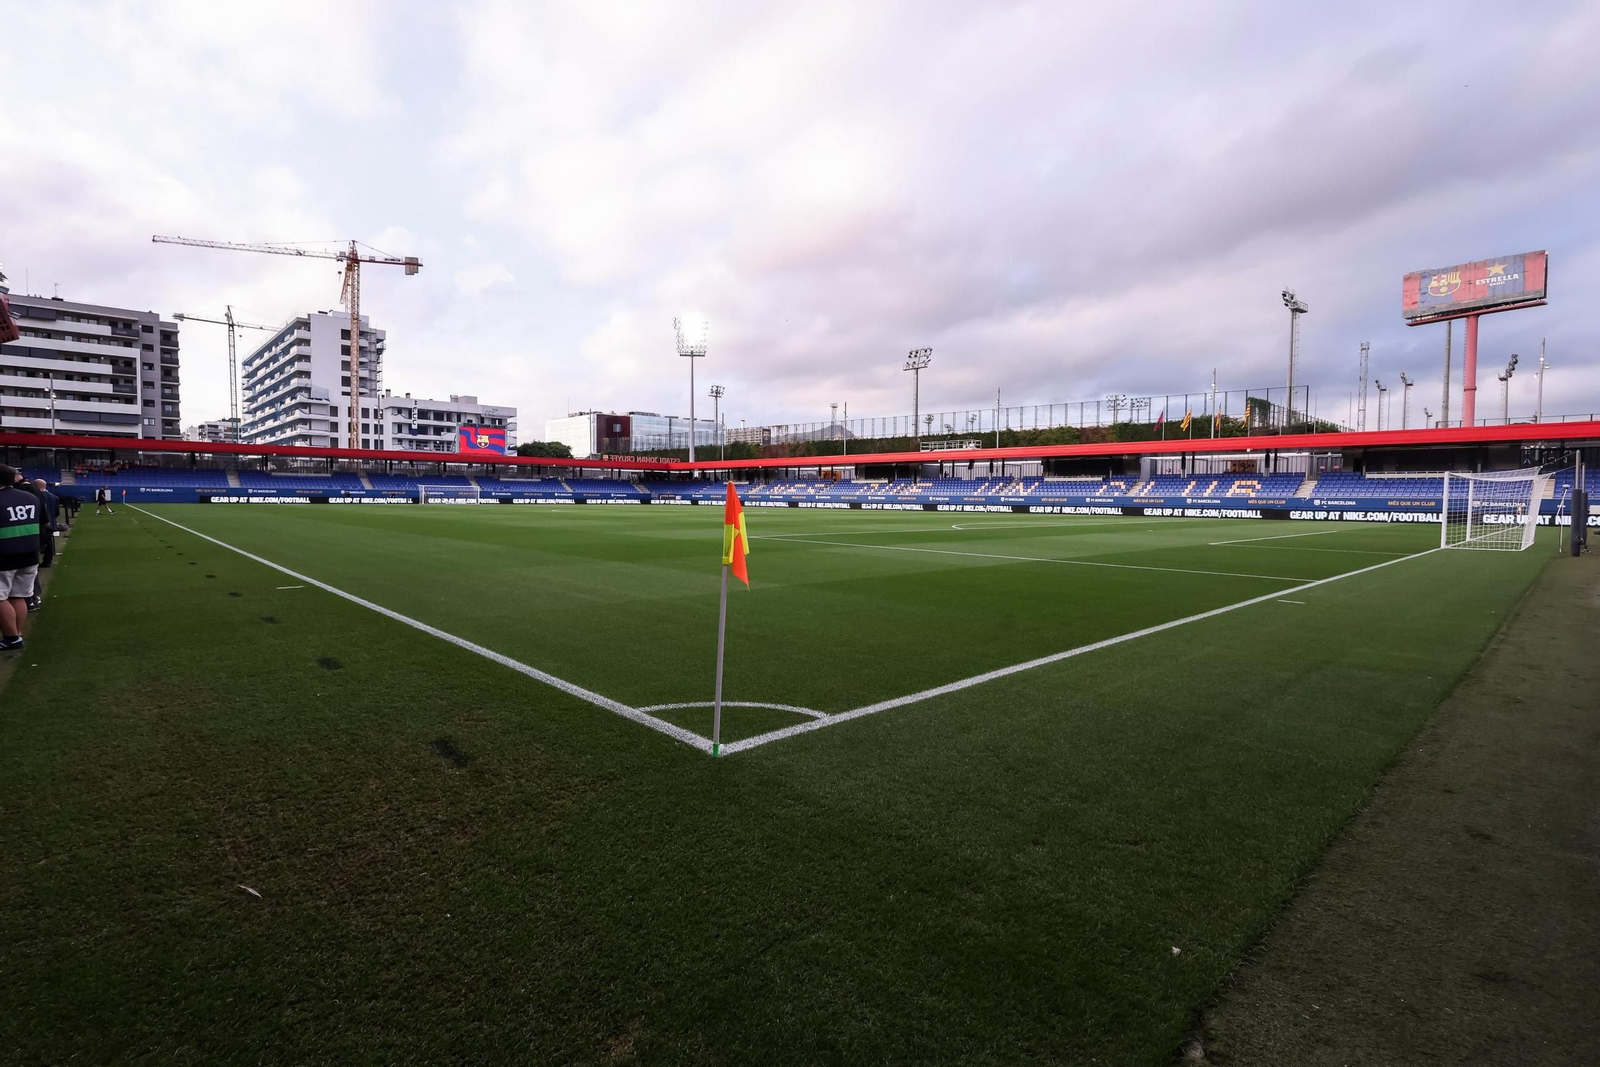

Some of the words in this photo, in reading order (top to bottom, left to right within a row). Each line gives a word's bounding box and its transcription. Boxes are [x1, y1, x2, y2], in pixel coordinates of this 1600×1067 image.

[1476, 274, 1519, 286] ESTRELLA
[6, 504, 35, 521] 187
[1185, 509, 1262, 518] NIKE.COM/FOOTBALL
[1290, 511, 1314, 520] GEAR
[1315, 511, 1327, 520] UP
[1328, 512, 1341, 520] AT
[1483, 515, 1514, 524] GEAR
[1536, 515, 1551, 525] AT
